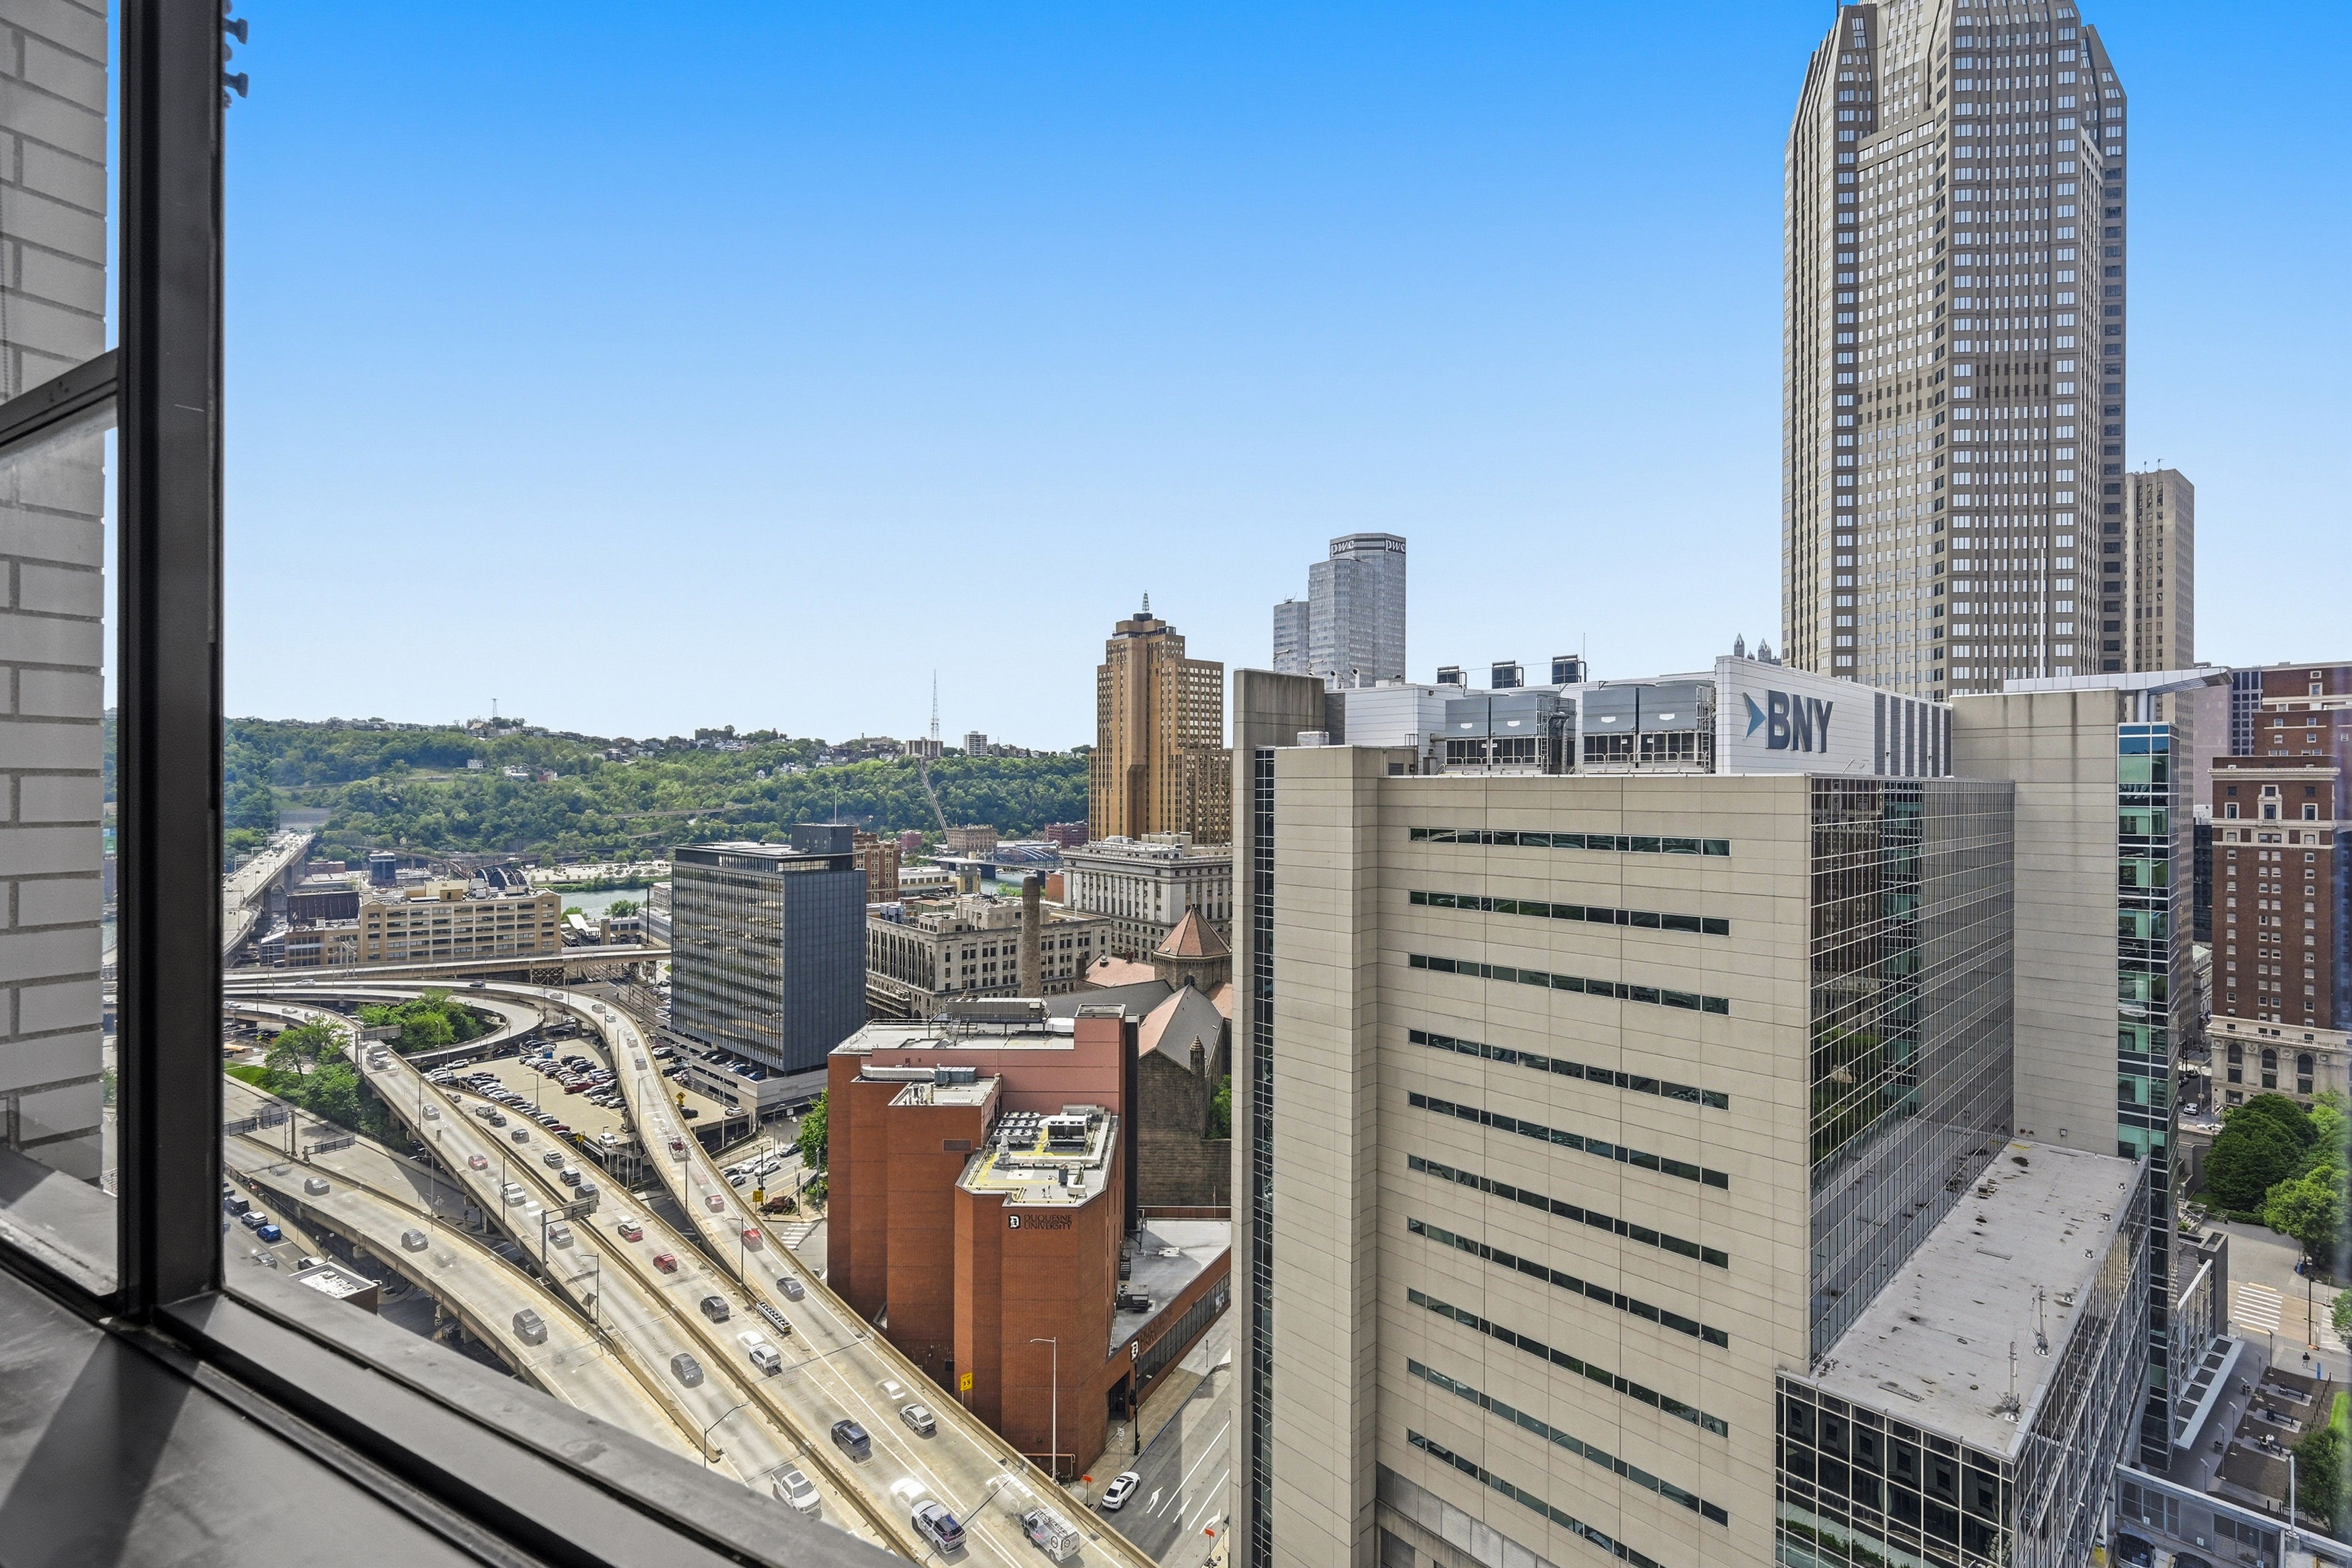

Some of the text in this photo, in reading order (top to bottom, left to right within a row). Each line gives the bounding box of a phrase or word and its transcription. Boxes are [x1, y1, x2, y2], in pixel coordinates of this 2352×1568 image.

[1330, 540, 1355, 557] pwc
[1385, 540, 1405, 552] pwc
[1766, 689, 1834, 753] BNY
[1024, 1214, 1073, 1223] DUQUESNE
